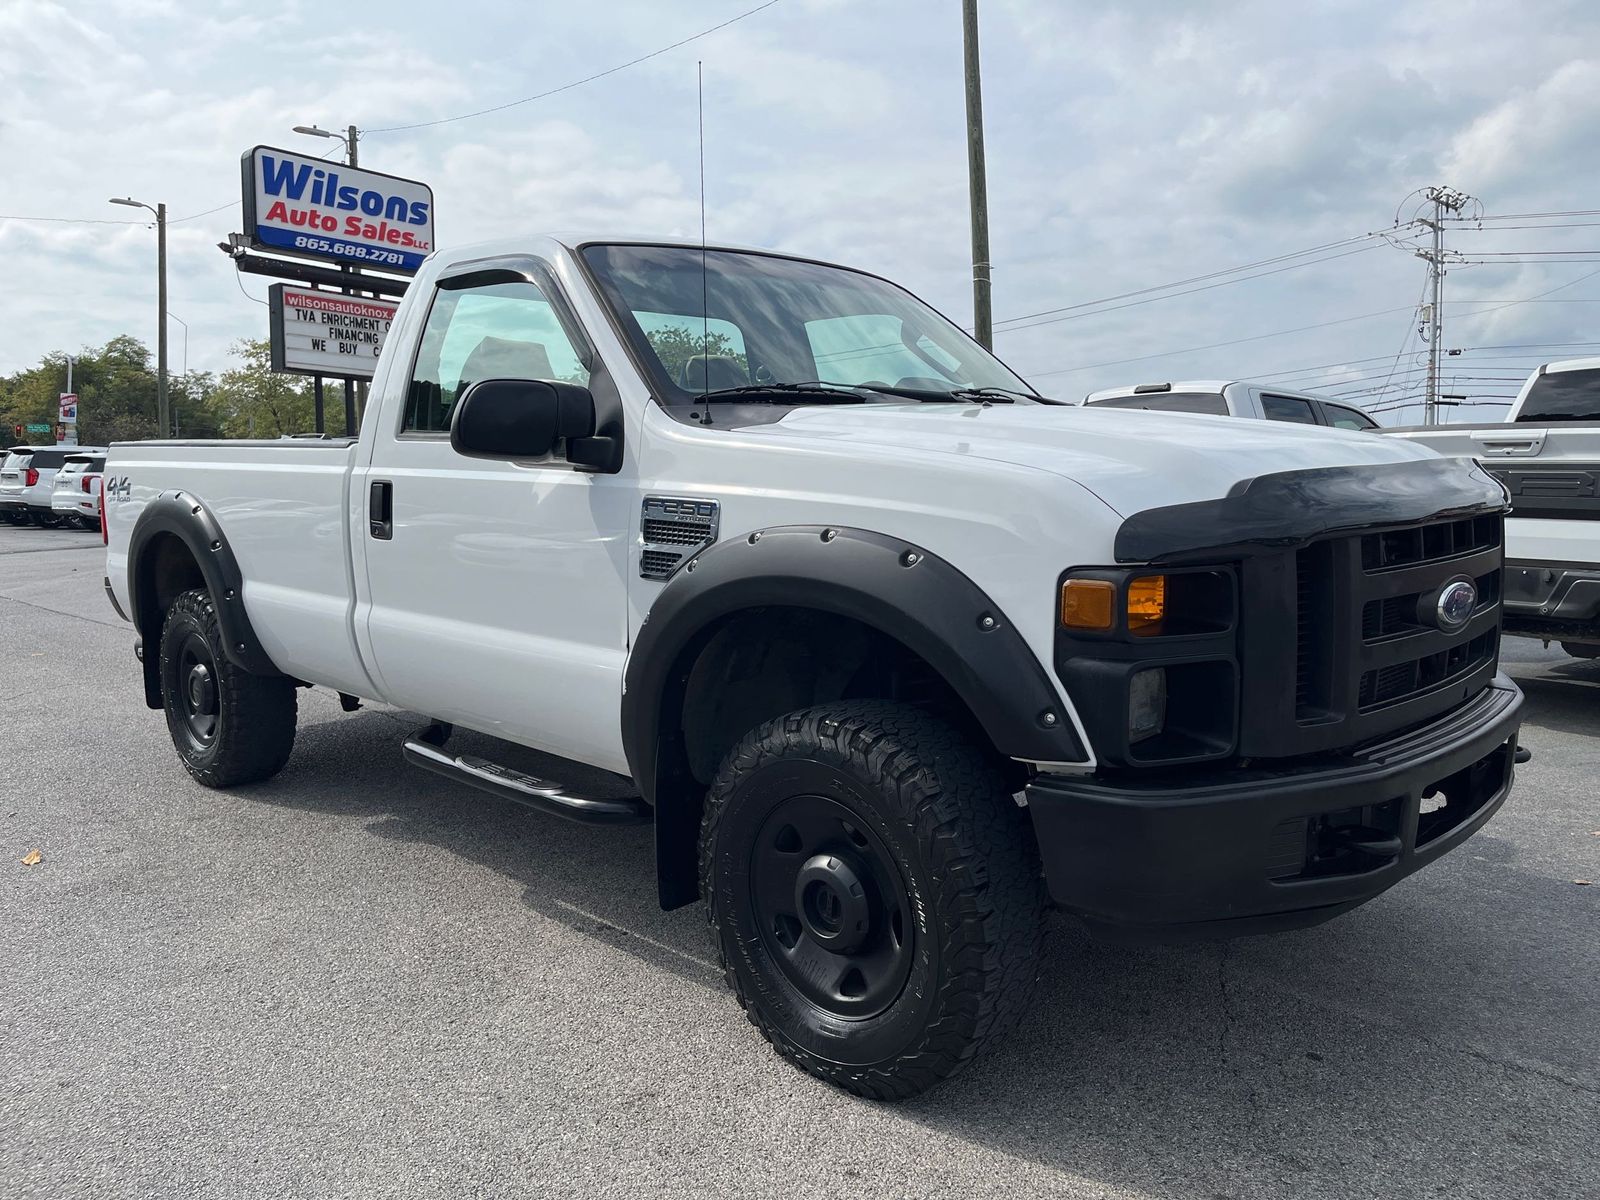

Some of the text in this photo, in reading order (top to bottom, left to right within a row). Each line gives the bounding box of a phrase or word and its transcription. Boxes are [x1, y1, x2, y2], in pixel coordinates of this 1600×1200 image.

[262, 155, 429, 226] Wilsons
[265, 201, 429, 250] Auto Sales LLC
[295, 236, 404, 265] 865.688.2781
[295, 308, 316, 322] TVA
[321, 312, 380, 331] ENRICHMENT
[311, 338, 382, 357] WE BUY C
[329, 327, 379, 344] FINANCING
